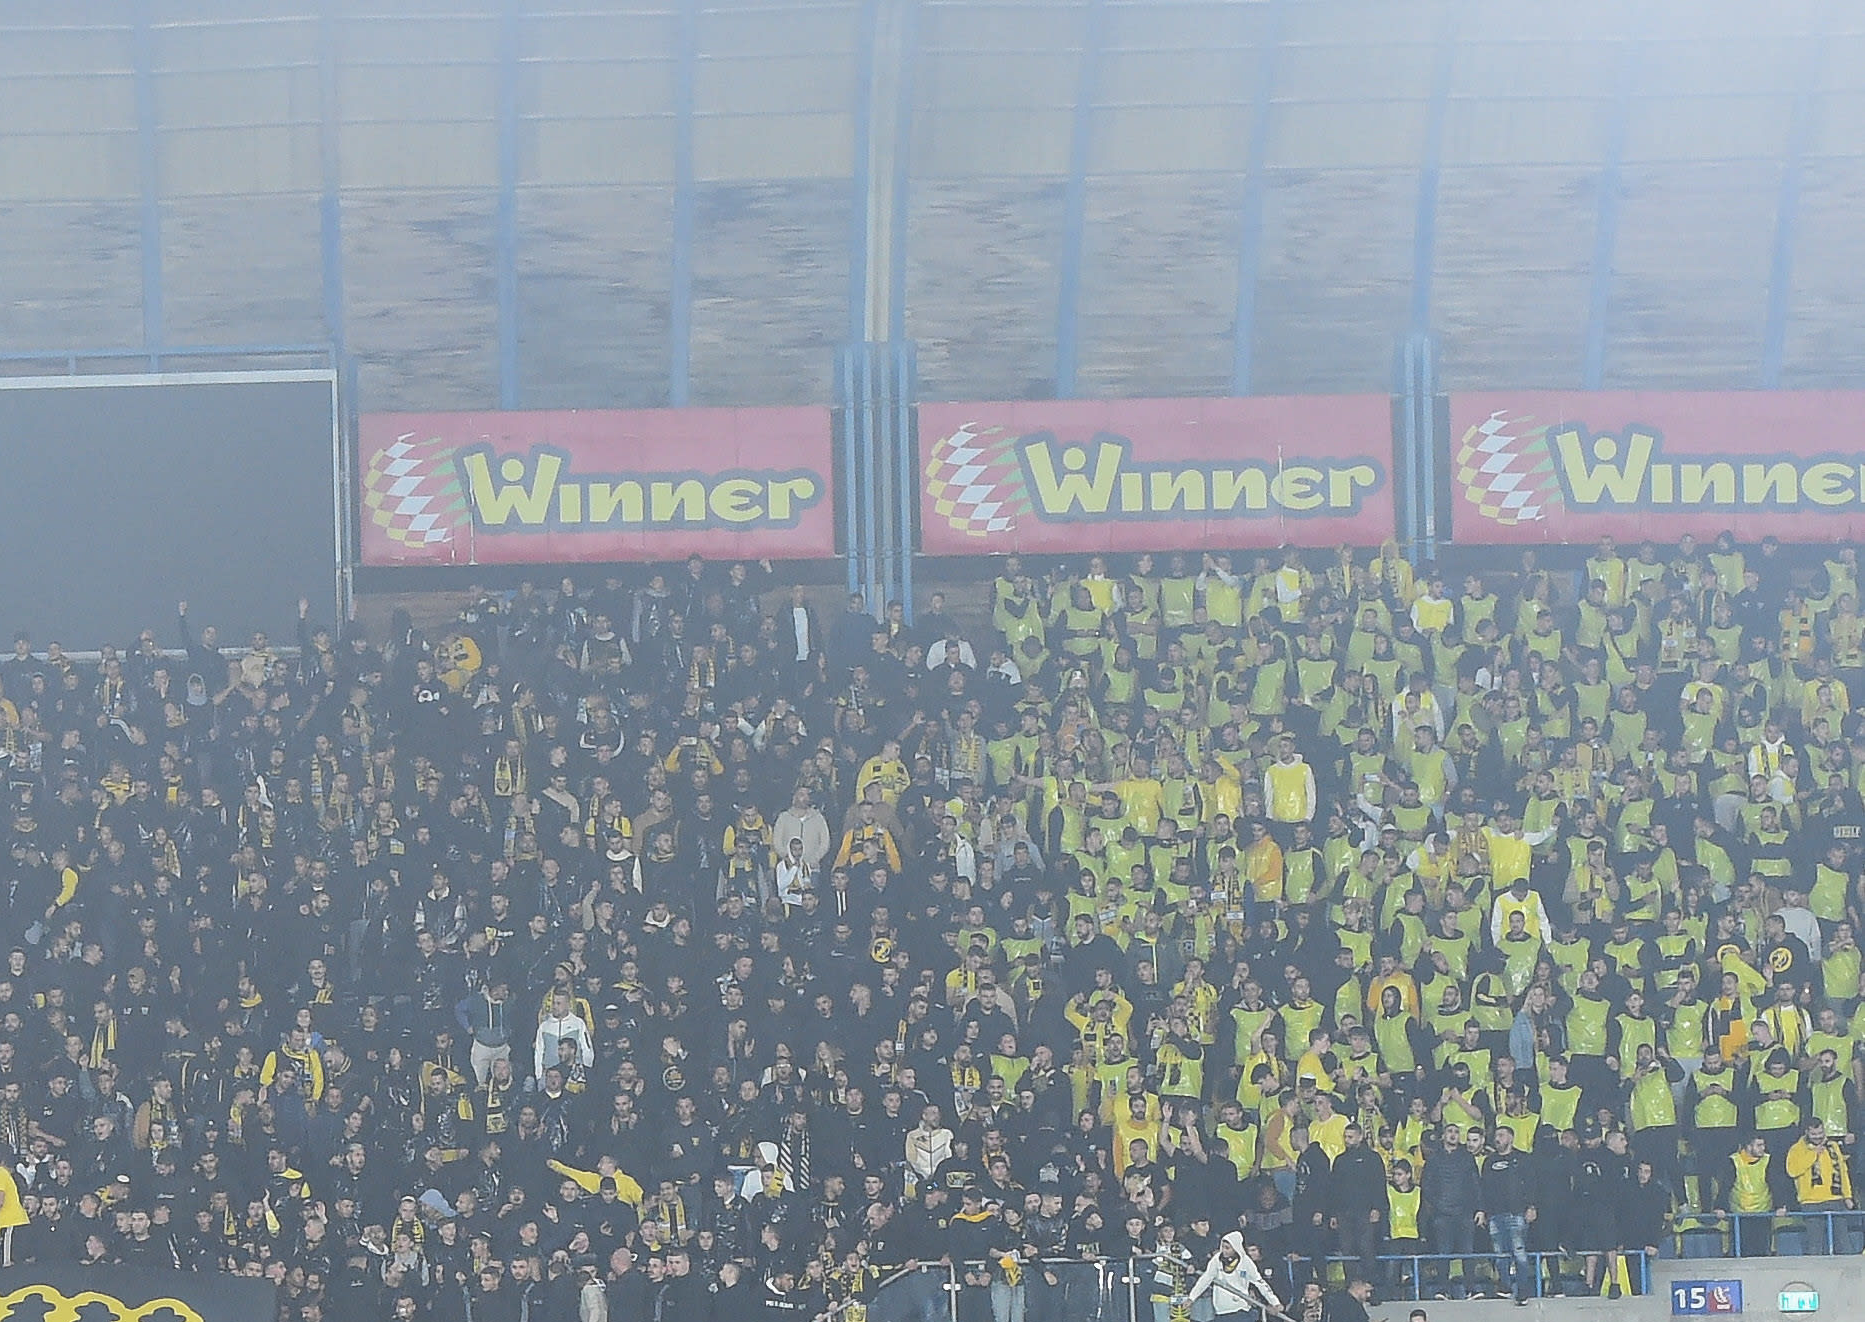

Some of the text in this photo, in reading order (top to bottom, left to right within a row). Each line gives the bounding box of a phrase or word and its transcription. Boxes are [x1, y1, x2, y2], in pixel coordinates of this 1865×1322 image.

[465, 451, 814, 526] Winner
[1023, 441, 1376, 514] Winner
[1556, 431, 1865, 507] Winne
[1674, 1286, 1706, 1309] 15
